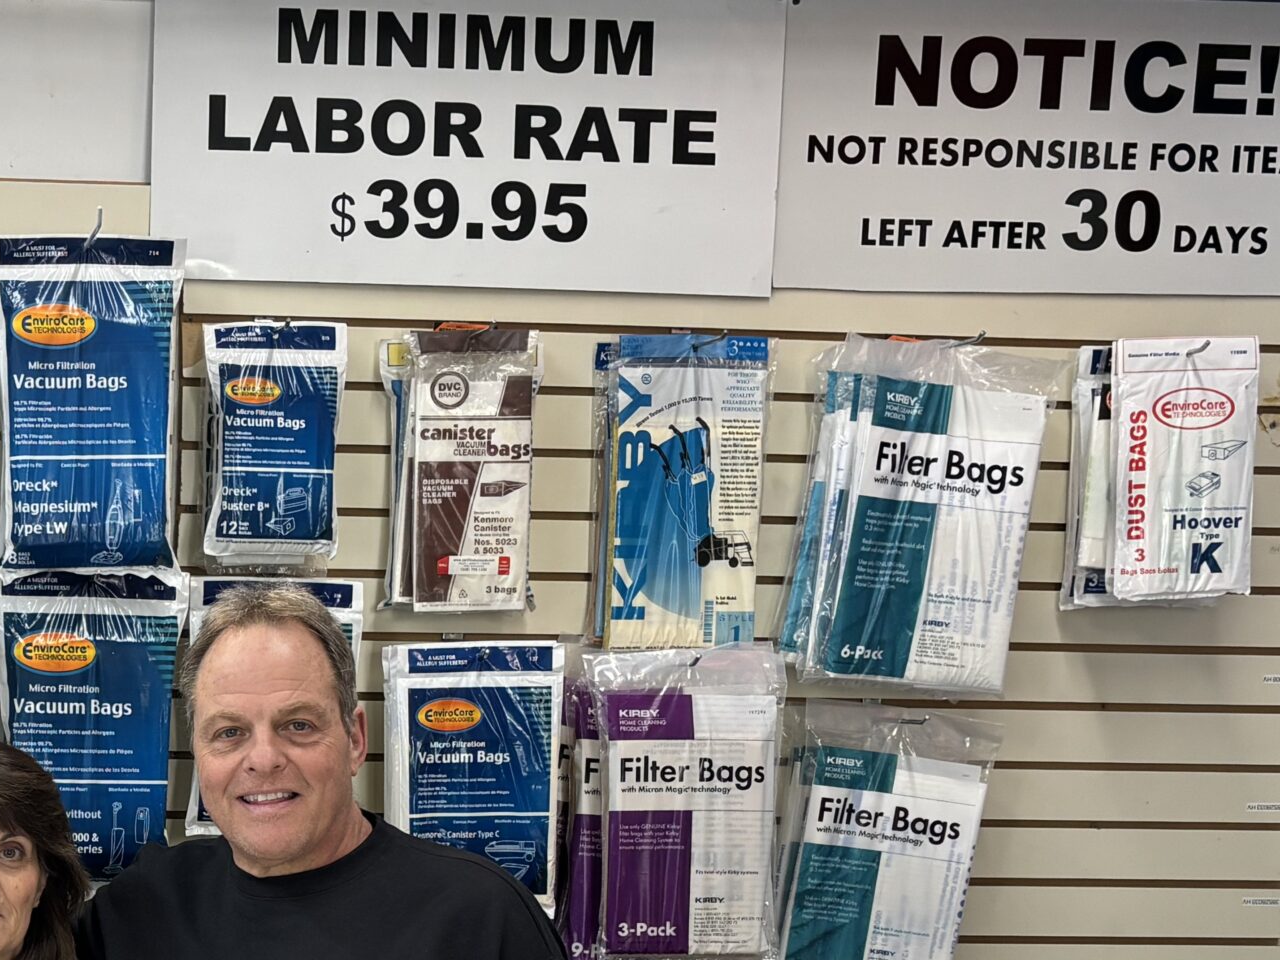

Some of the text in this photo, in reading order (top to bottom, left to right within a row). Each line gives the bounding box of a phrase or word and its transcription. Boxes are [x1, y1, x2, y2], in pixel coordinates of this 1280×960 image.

[277, 7, 655, 77] MINIMUM
[874, 34, 1280, 116] NOTICE!
[207, 94, 719, 167] LABOR RATE
[806, 134, 1280, 174] NOT RESPONSIBLE FOR ITE
[329, 178, 588, 243] $39.95
[860, 188, 1269, 255] LEFT AFTER 30 DAYS
[728, 341, 738, 356] 3
[14, 373, 127, 391] Vacuum Bags
[438, 383, 461, 392] DVC
[438, 391, 462, 399] BRAND
[1161, 400, 1226, 418] EnviroCare
[420, 425, 496, 441] canister
[453, 448, 486, 456] CLEANER
[456, 440, 530, 459] VACUUM bags
[945, 450, 1024, 495] Bags
[1127, 410, 1148, 541] DUST BAGS
[1172, 514, 1242, 530] Hoover
[1200, 532, 1220, 540] Type
[1135, 549, 1145, 562] 3
[1190, 542, 1224, 574] K
[494, 586, 517, 594] bags
[719, 614, 754, 622] STYLE
[840, 645, 884, 660] 6-Pack
[14, 698, 132, 718] Vacuum Bags
[619, 709, 660, 718] KIRBY
[418, 751, 510, 766] Vacuum Bags
[620, 756, 765, 791] Filter Bags
[691, 785, 731, 795] technology
[817, 797, 960, 845] Filter Bags
[618, 922, 676, 938] 3-Pack
